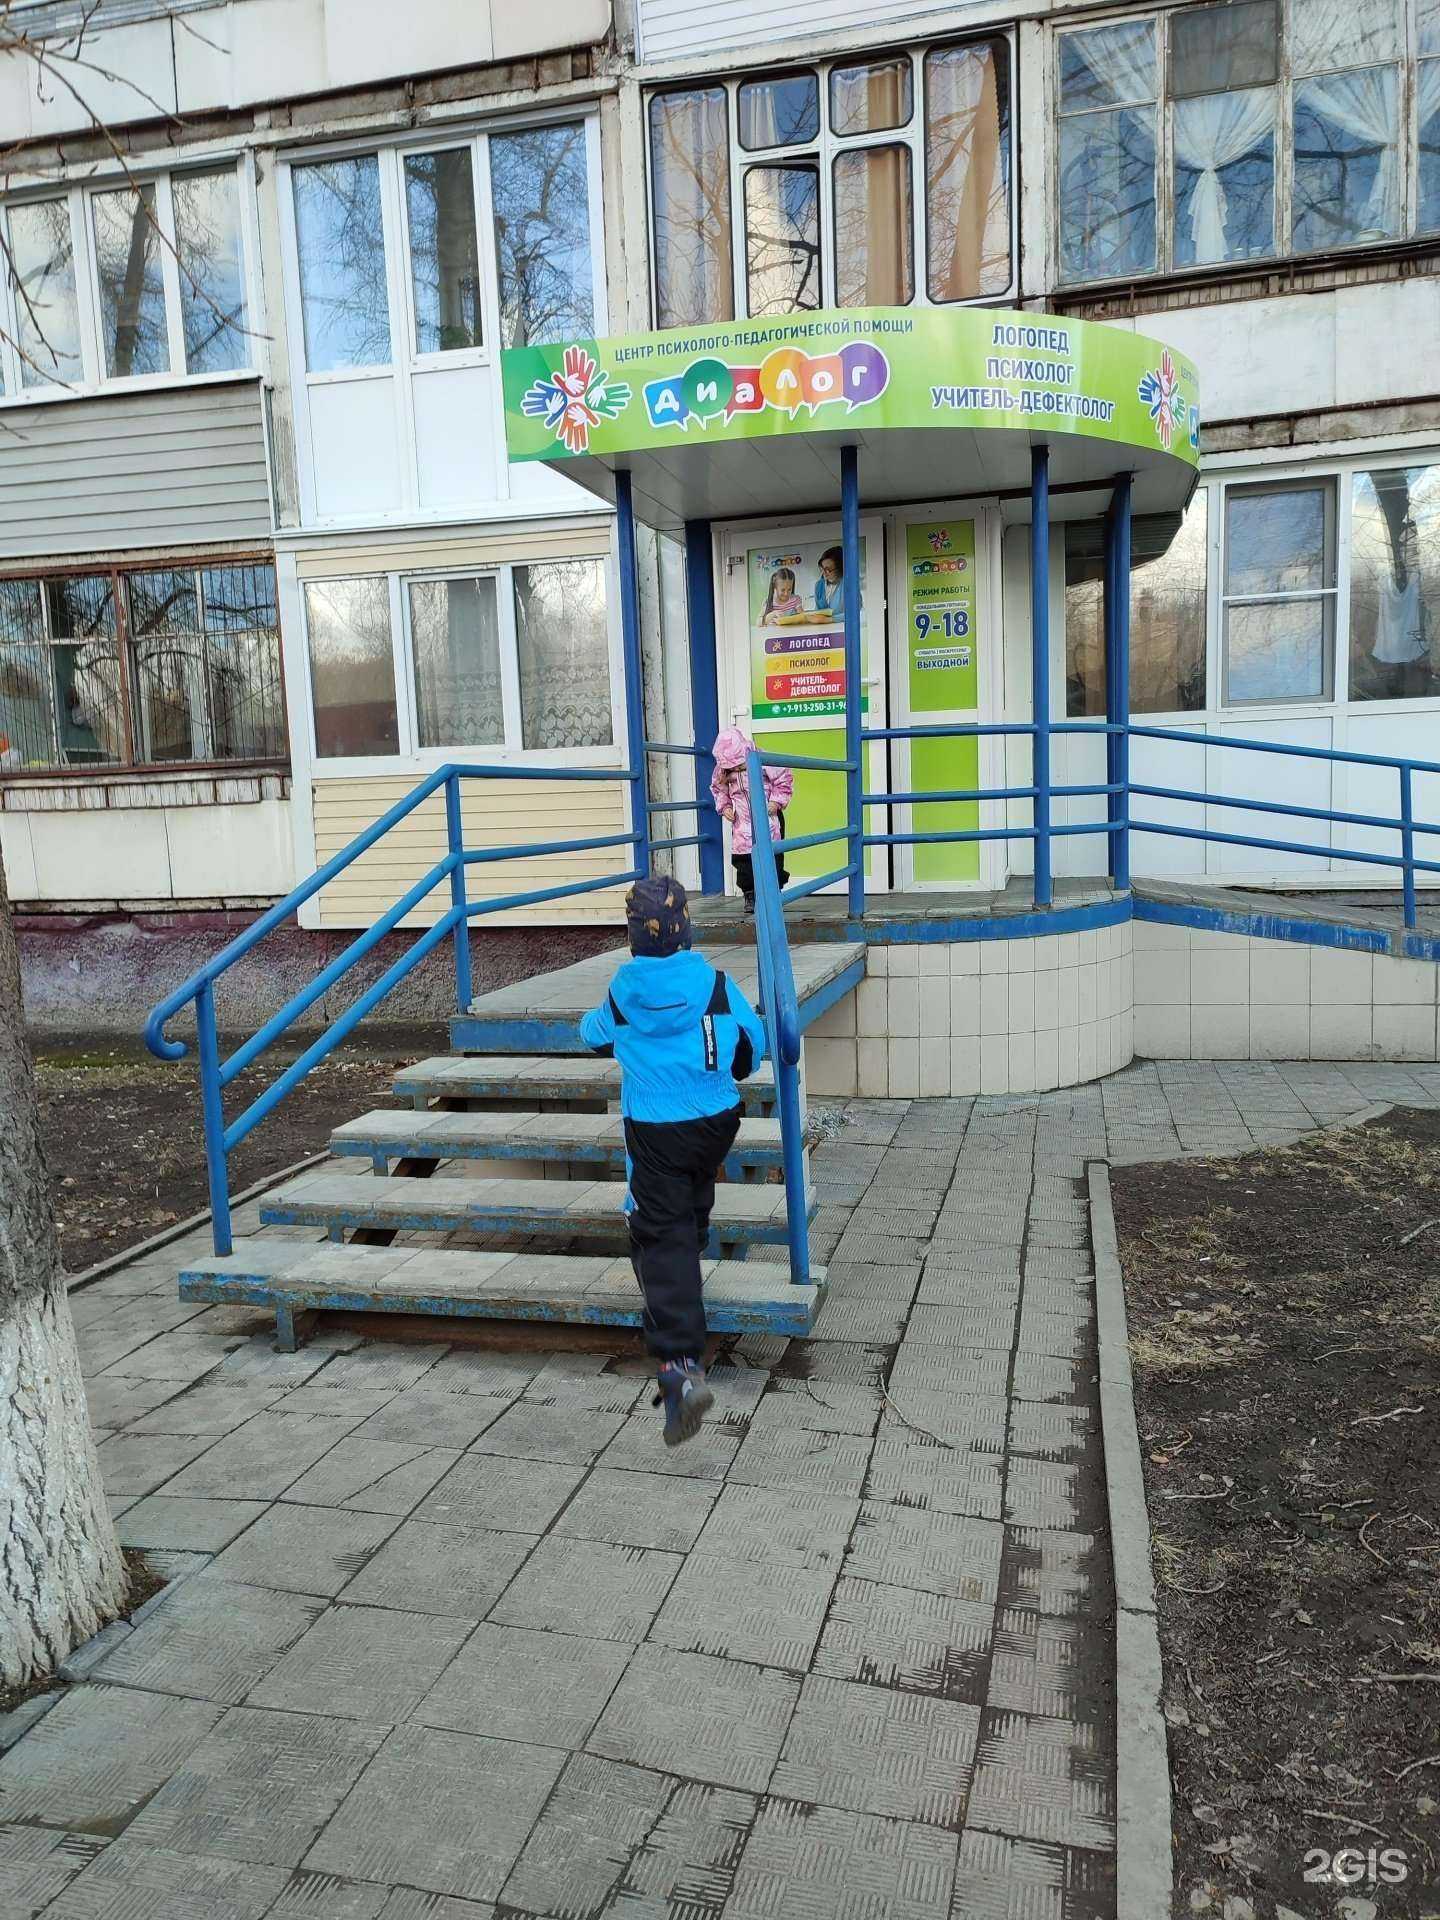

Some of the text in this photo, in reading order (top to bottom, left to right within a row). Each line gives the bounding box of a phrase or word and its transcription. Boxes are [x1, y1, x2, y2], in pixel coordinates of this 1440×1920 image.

[614, 318, 914, 363] ЦЕНТР ПСИХОЛОГО-ПЕДАГОГИЧЕСКОЙ ПОМОЩИ
[993, 325, 1069, 354] ЛОГОПЕД
[987, 358, 1074, 384] ПСИХОЛОГ
[931, 387, 1115, 421] УЧИТЕЛЬ-ДЕФЕКТОЛОГ
[912, 584, 970, 597] РЕЖИМ РАБОТЫ
[915, 611, 969, 639] 9-18
[789, 636, 831, 649] ЛОГОПЕД
[789, 656, 830, 668] ПСИХОЛОГ
[916, 655, 969, 670] ВЫХОДНОЙ
[790, 675, 828, 686] УЧИТЕЛЬ-
[790, 683, 841, 697] ДЕФЕКТОЛОГ
